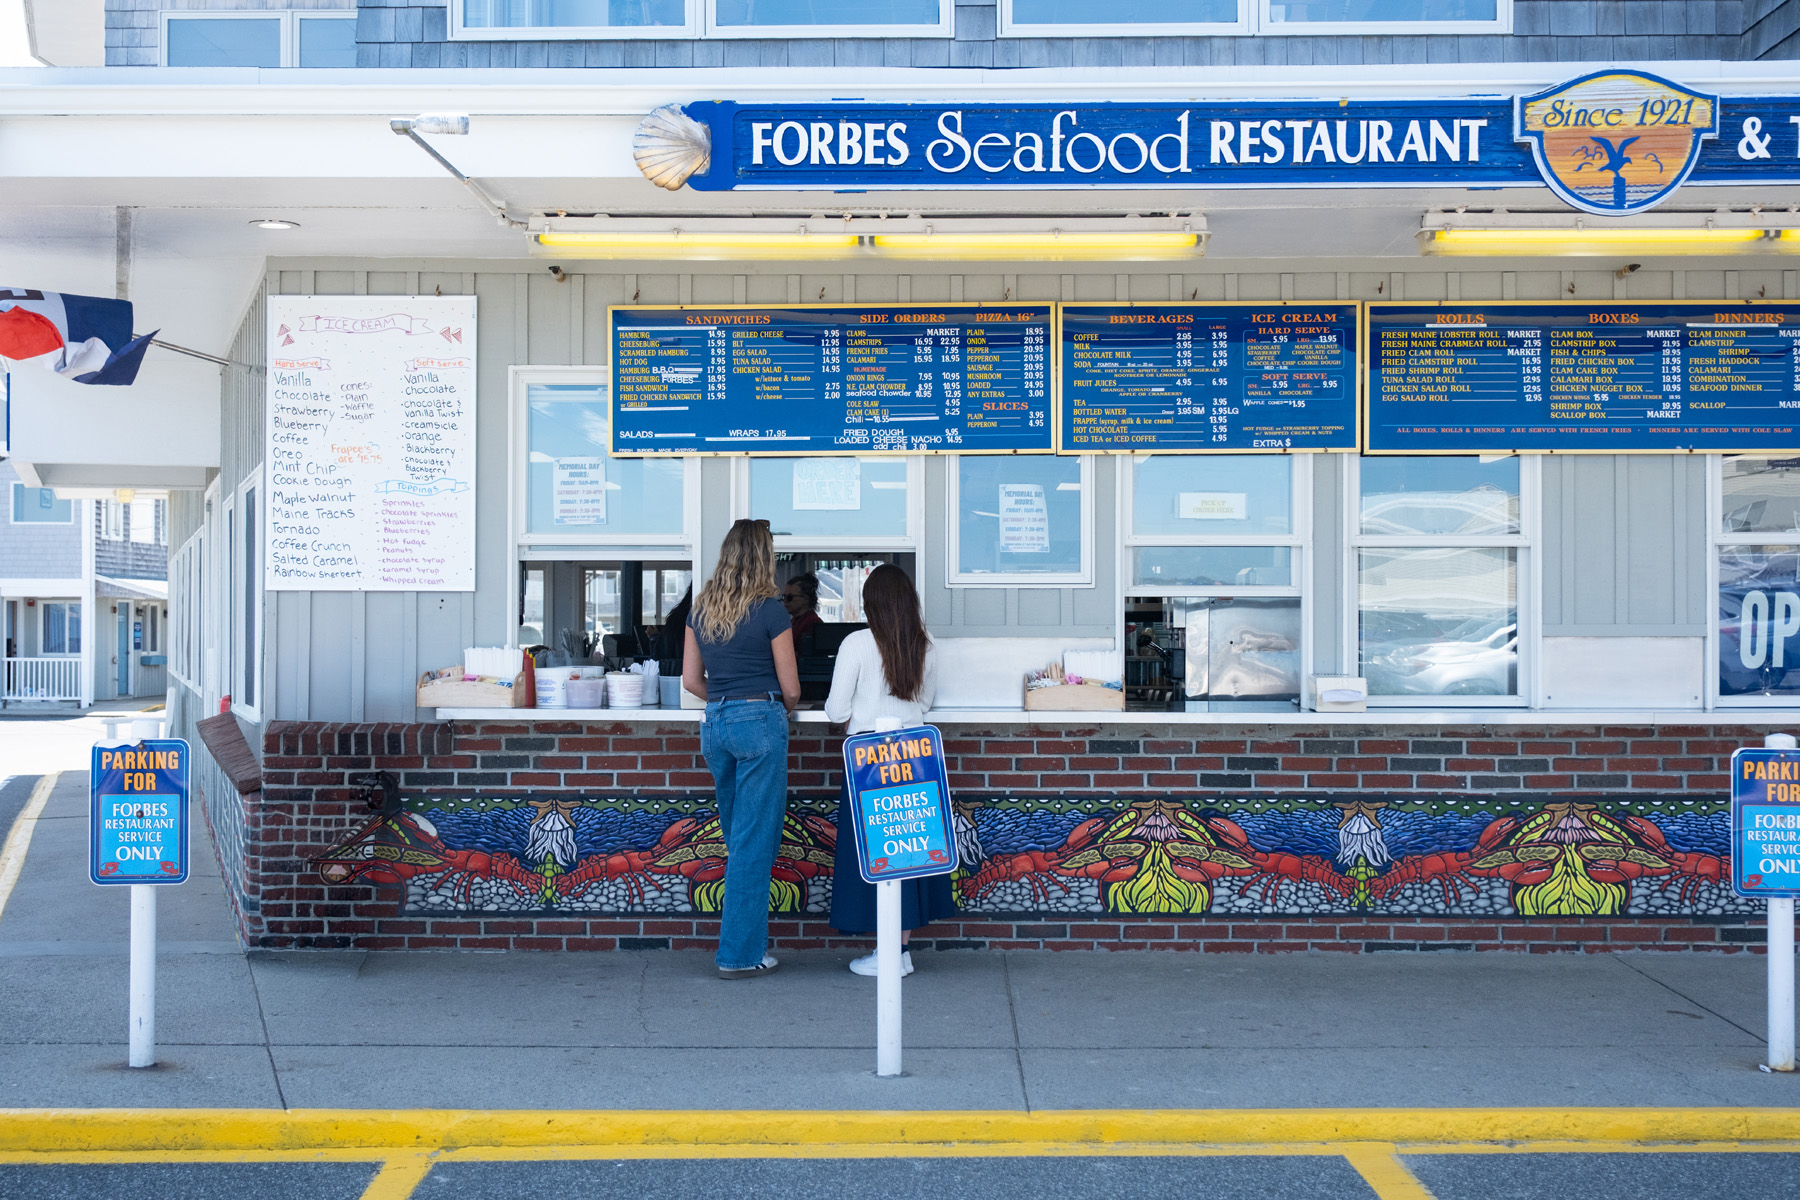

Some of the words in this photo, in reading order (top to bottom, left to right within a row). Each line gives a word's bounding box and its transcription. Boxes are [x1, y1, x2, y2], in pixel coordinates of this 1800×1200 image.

[1543, 99, 1623, 127] Since
[1636, 99, 1694, 126] 1921
[752, 121, 909, 166] FORBES
[926, 110, 1192, 174] Seafood
[1210, 119, 1487, 164] RESTAURANT
[1738, 117, 1771, 160] &
[686, 315, 770, 325] SANDWICHES
[860, 315, 889, 324] SIDE
[894, 314, 945, 323] ORDERS
[976, 313, 1010, 322] PIZZA
[1109, 315, 1194, 324] BEVERAGES
[1252, 314, 1276, 323] ICE
[1281, 314, 1337, 323] CREAM
[1436, 314, 1484, 324] ROLLS
[1589, 314, 1639, 323] BOXES
[1714, 313, 1784, 323] DINNERS
[324, 319, 348, 331] ICE
[352, 318, 397, 331] CREAM
[1212, 332, 1227, 340] 3.95
[1074, 351, 1115, 359] CHOCOLATE
[1117, 351, 1131, 359] MILK
[274, 372, 312, 386] Vanilla
[404, 372, 439, 384] Vanilla
[662, 376, 694, 384] FORBES
[275, 390, 331, 402] Chocolate
[983, 402, 1028, 411] SLICES
[274, 404, 335, 422] Strawberry
[274, 417, 328, 436] Blueberry
[1074, 426, 1086, 434] HOT
[273, 434, 309, 445] Coffee
[834, 436, 869, 444] LOADED
[873, 436, 908, 444] CHEESE
[1285, 438, 1291, 447] $
[273, 448, 302, 459] Oreo
[406, 444, 455, 458] Blackberry
[338, 455, 354, 463] are
[273, 461, 301, 472] Mint
[306, 462, 336, 475] Chip
[273, 474, 308, 485] Cookie
[315, 477, 352, 489] Dough
[398, 482, 439, 494] Toppings
[798, 481, 856, 504] HERE
[273, 491, 307, 506] Maple
[273, 507, 310, 519] Maine
[316, 508, 355, 519] Tracks
[273, 522, 320, 535] Tornado
[272, 539, 307, 550] Coffee
[311, 540, 350, 551] Crunch
[273, 552, 308, 565] Salted
[313, 554, 358, 567] Caramel
[274, 565, 316, 577] Rainbow
[855, 738, 932, 766] PARKING
[102, 751, 178, 770] PARKING
[880, 763, 913, 784] FOR
[1744, 761, 1798, 780] PARKI
[124, 773, 156, 791] FOR
[1767, 784, 1800, 802] FOR
[873, 791, 928, 812] FORBES
[113, 803, 167, 817] FORBES
[869, 806, 936, 826] RESTAURANT
[105, 819, 174, 829] RESTAURANT
[883, 821, 926, 837] SERVICE
[119, 832, 162, 842] SERVICE
[884, 836, 929, 856] ONLY
[116, 846, 163, 861] ONLY
